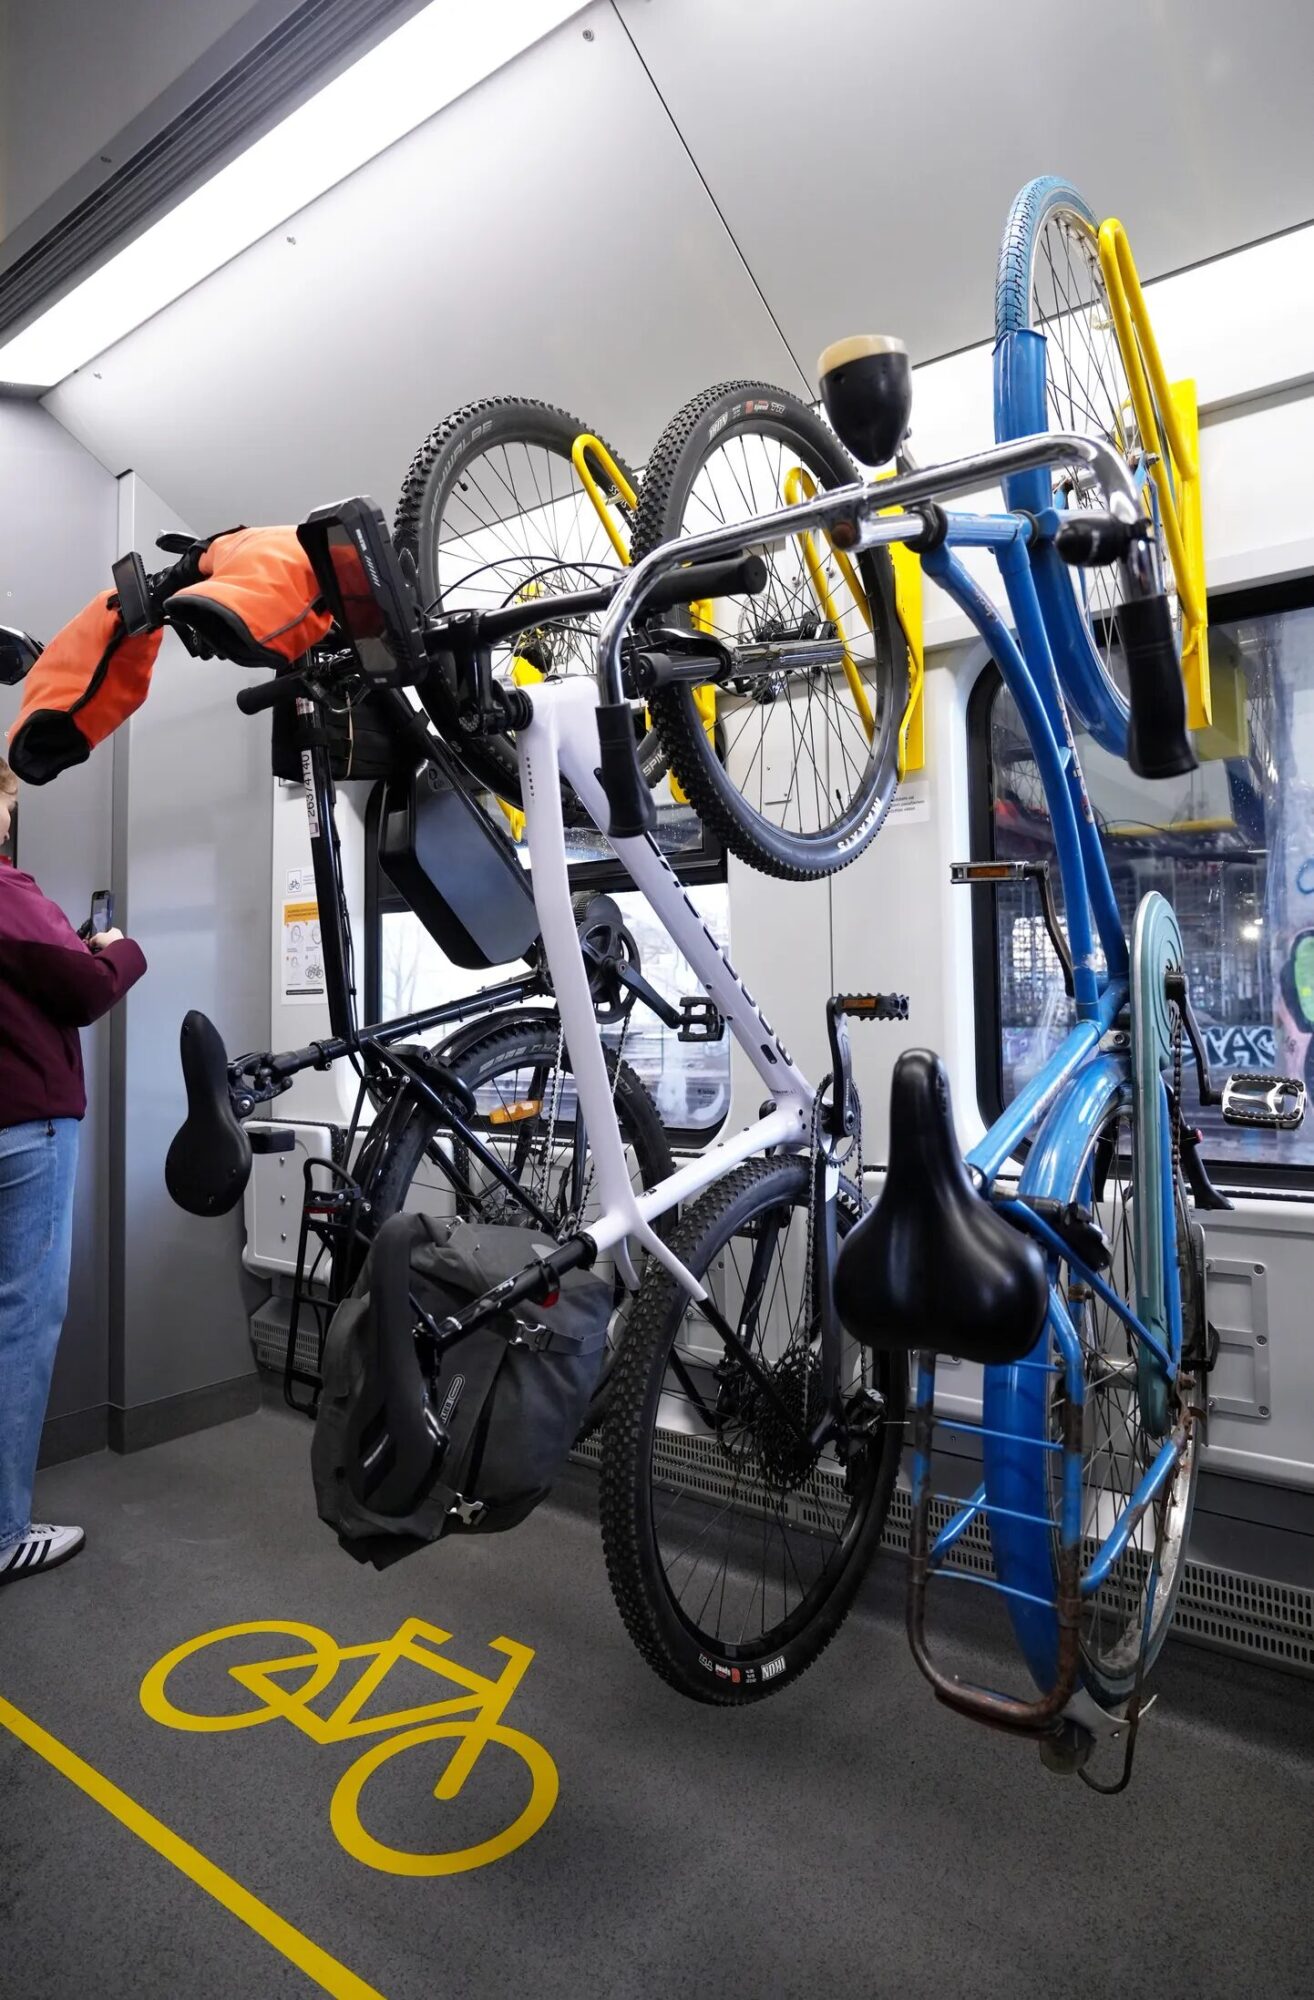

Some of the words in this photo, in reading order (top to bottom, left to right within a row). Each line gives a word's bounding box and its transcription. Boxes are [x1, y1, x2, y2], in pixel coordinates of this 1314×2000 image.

[430, 420, 493, 522] SCHWALBE
[837, 797, 883, 854] MAXXIS
[760, 1654, 787, 1681] IKON
